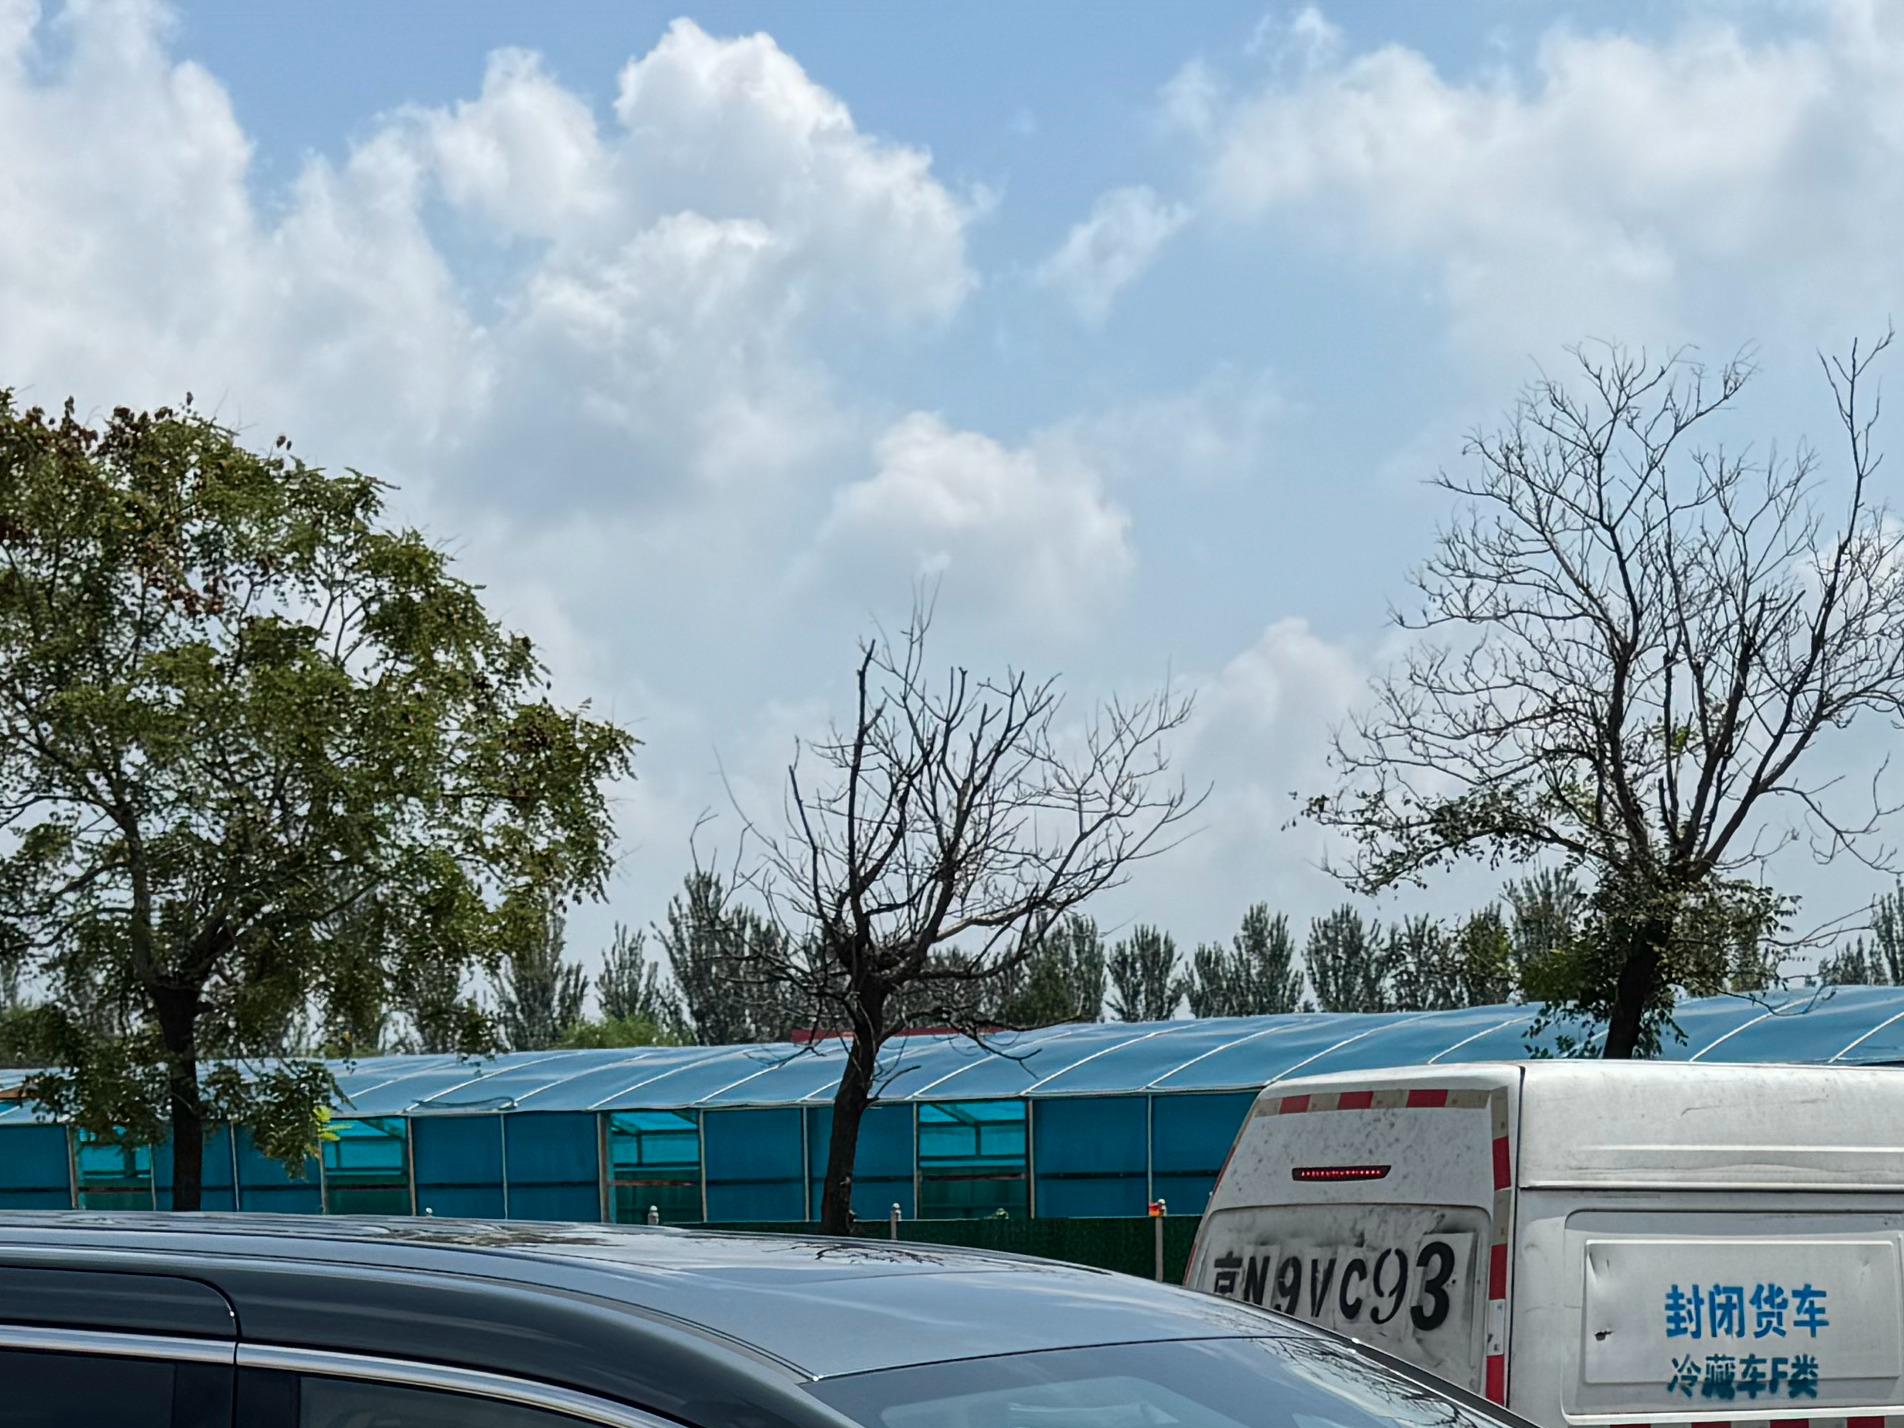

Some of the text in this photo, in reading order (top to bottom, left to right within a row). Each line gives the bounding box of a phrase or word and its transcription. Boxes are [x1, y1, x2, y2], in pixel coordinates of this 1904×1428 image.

[1665, 1283, 1830, 1339] 封闭货车
[1667, 1353, 1819, 1400] 冷藏车F类
